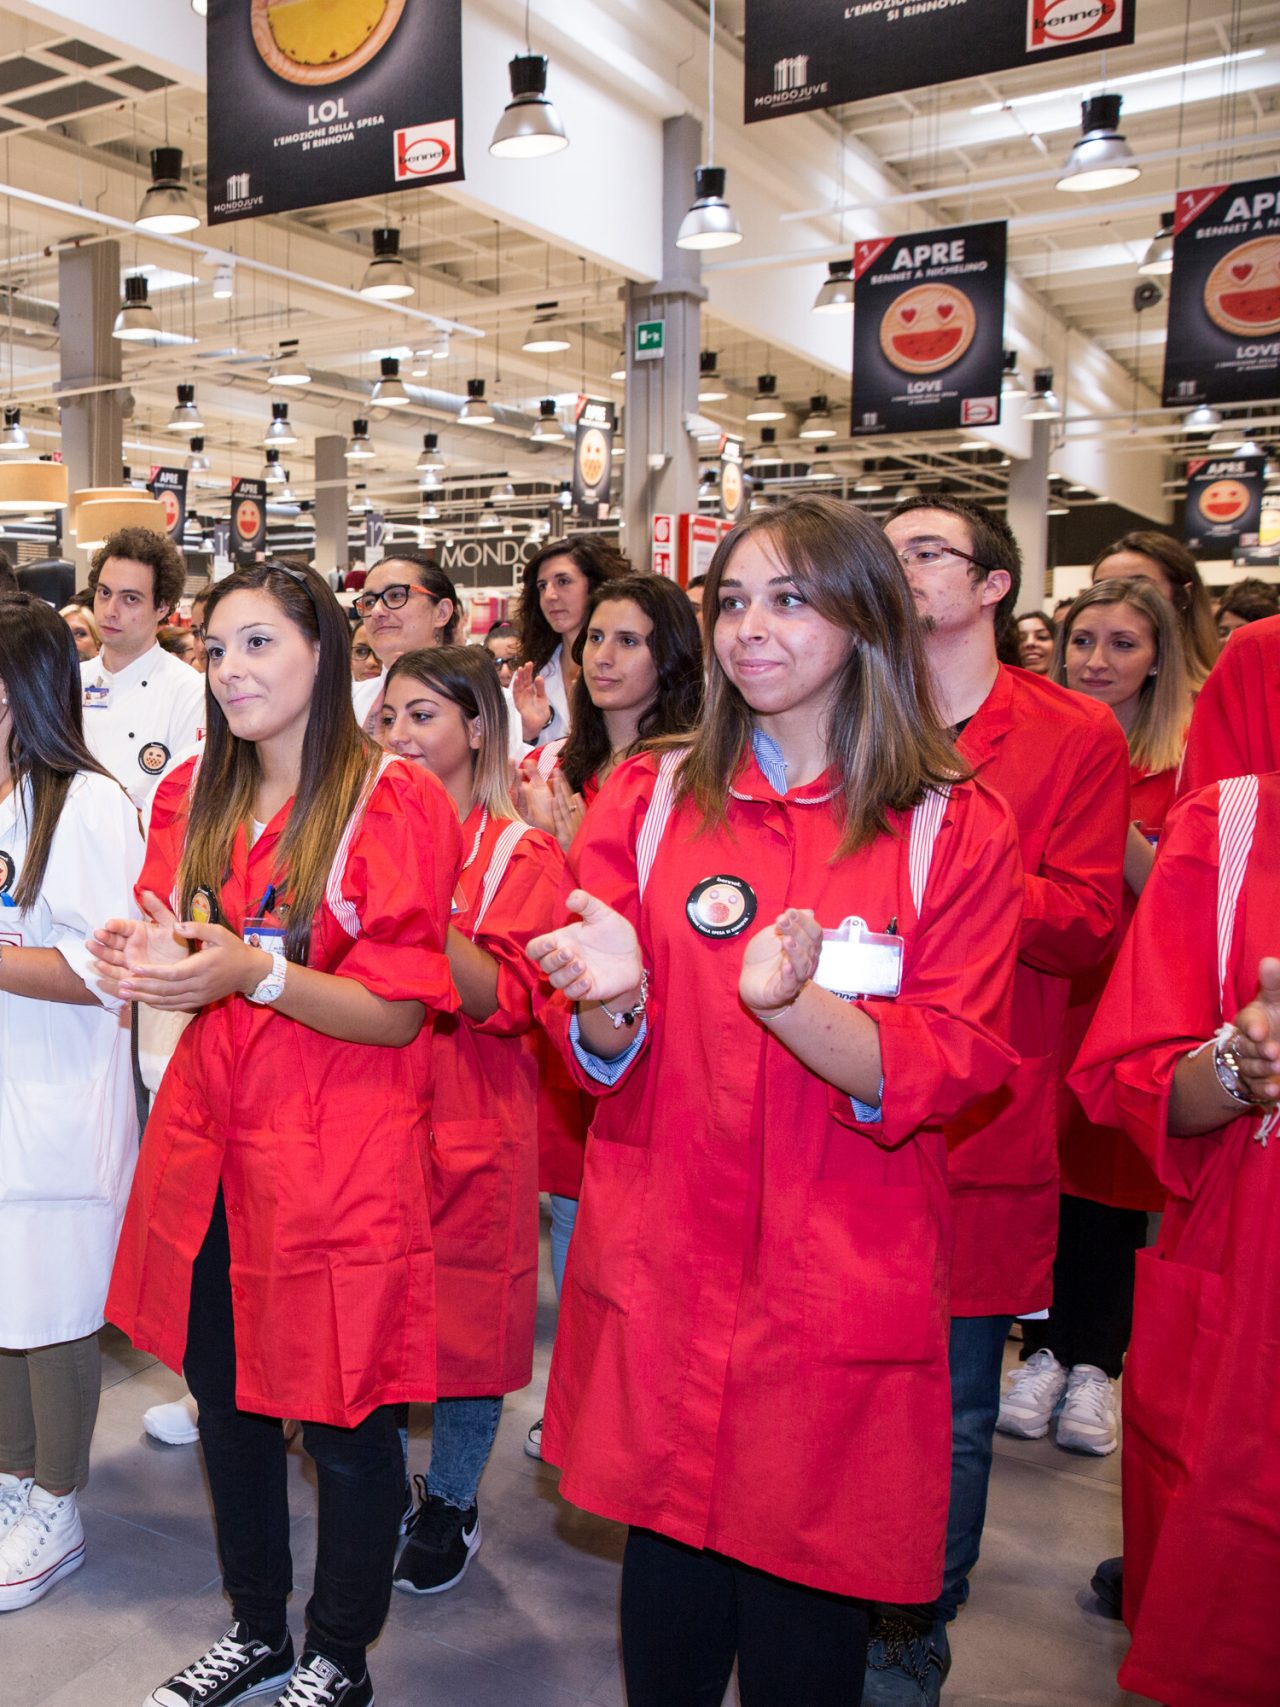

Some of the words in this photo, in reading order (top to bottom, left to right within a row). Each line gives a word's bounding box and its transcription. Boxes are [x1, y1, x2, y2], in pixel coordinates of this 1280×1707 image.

[844, 0, 921, 19] L'EMOZIO
[887, 9, 900, 21] SI
[1033, 3, 1112, 29] bennet
[754, 81, 829, 107] MONDOJUVE
[308, 97, 349, 126] LOL
[273, 127, 327, 147] L'EMOZIONE
[328, 121, 355, 134] DELLA
[356, 114, 386, 129] SPESA
[302, 141, 311, 151] SI
[312, 132, 355, 148] RINNOVA
[213, 195, 264, 212] MONDOJUVE
[891, 238, 966, 271] APRE
[914, 269, 924, 279] A
[1235, 342, 1280, 359] LOVE
[906, 379, 943, 394] LOVE
[368, 520, 385, 548] 12
[440, 540, 543, 568] MONDO
